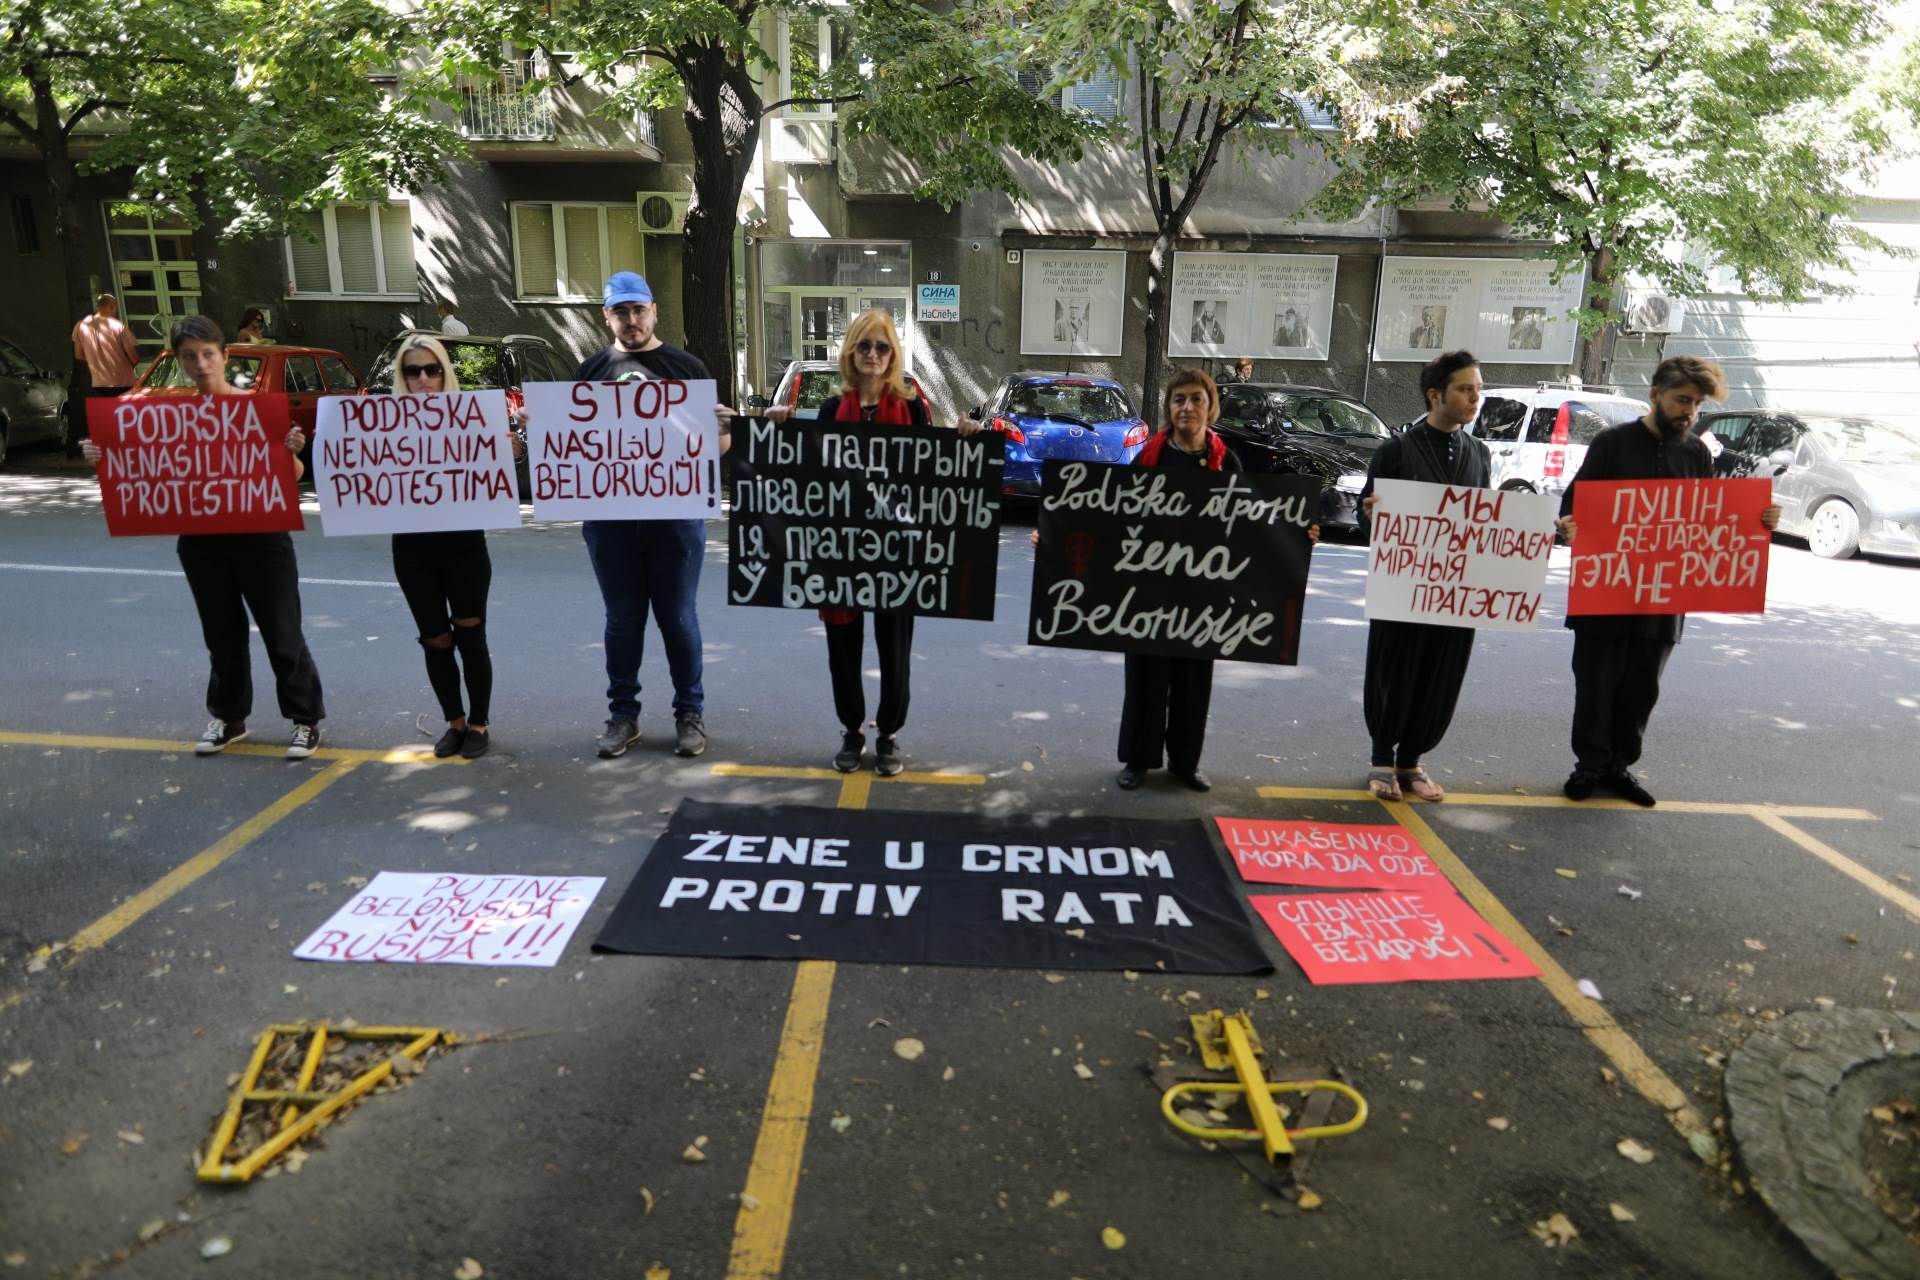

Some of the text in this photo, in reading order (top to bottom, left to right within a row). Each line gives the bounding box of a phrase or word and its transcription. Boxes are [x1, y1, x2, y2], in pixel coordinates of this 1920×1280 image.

[922, 287, 956, 298] СИНА
[929, 272, 939, 280] 18
[115, 395, 266, 443] PODRŠKA
[340, 394, 487, 432] PODRŠKA
[569, 380, 688, 422] STOP
[107, 441, 271, 480] NENASILNIM
[324, 434, 496, 469] NENASILNIM
[749, 418, 803, 465] Мы
[116, 475, 287, 517] PROTESTIMA
[330, 468, 513, 508] PROTESTIMA
[1043, 461, 1311, 539] Podrška otporu
[1437, 486, 1504, 524] МЫ
[1113, 524, 1250, 581] žena
[1372, 511, 1556, 561] ПАДТРЫМЛІВАЕМ
[1373, 546, 1468, 583] МІРНЫЯ
[1570, 549, 1761, 604] ГЭТА НЕ РУСІЯ
[1035, 578, 1275, 656] Belorusije
[1410, 584, 1542, 624] ПРАТЭСТЫ
[682, 830, 1174, 878] ŽENE U CRNOM
[1231, 826, 1410, 853] LUKAŠENKO
[1237, 849, 1436, 876] MORA DA ODE
[351, 896, 554, 919] BELORUSIJA
[658, 877, 1193, 926] PROTIV RATA
